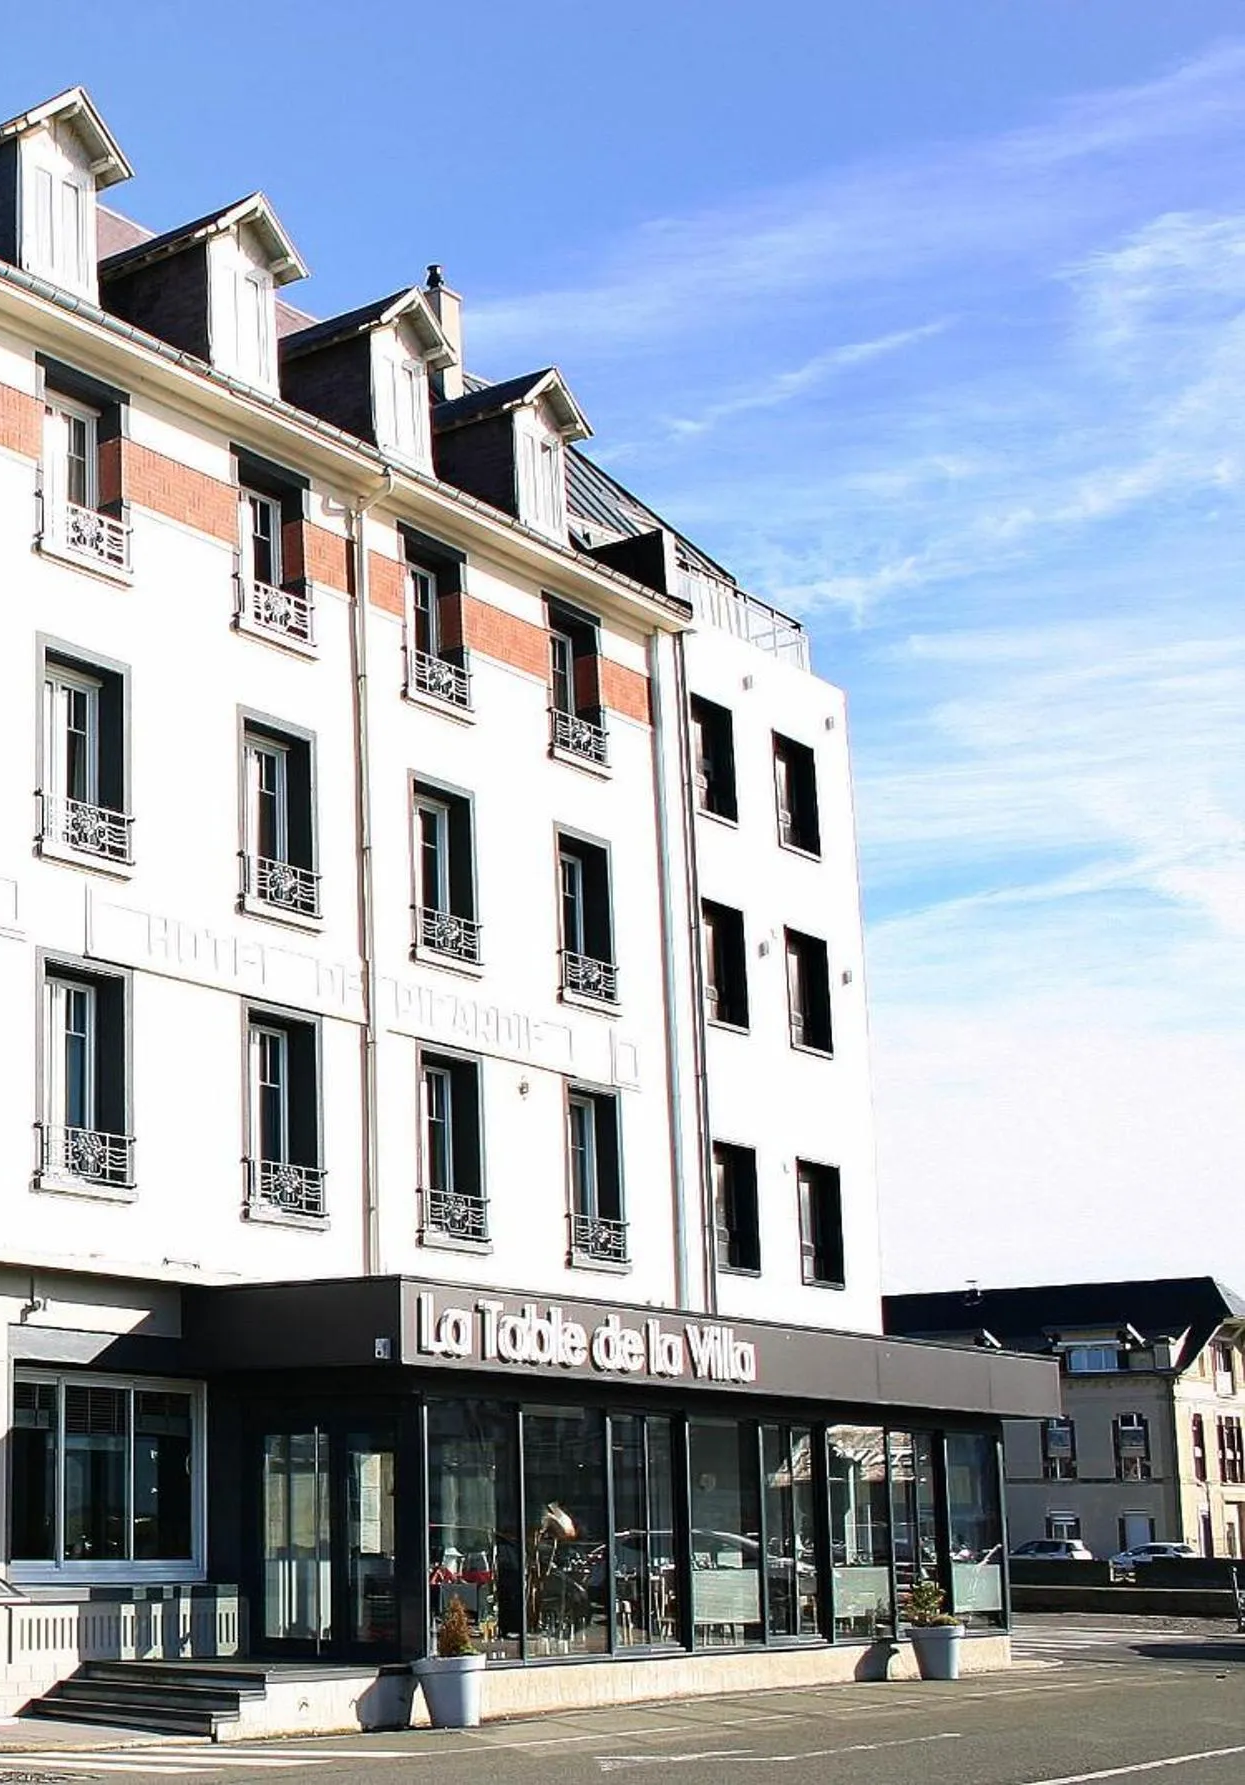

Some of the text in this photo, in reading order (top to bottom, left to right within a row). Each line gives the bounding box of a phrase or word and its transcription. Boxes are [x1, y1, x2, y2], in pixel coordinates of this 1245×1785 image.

[418, 1291, 756, 1383] La Table de la Villa
